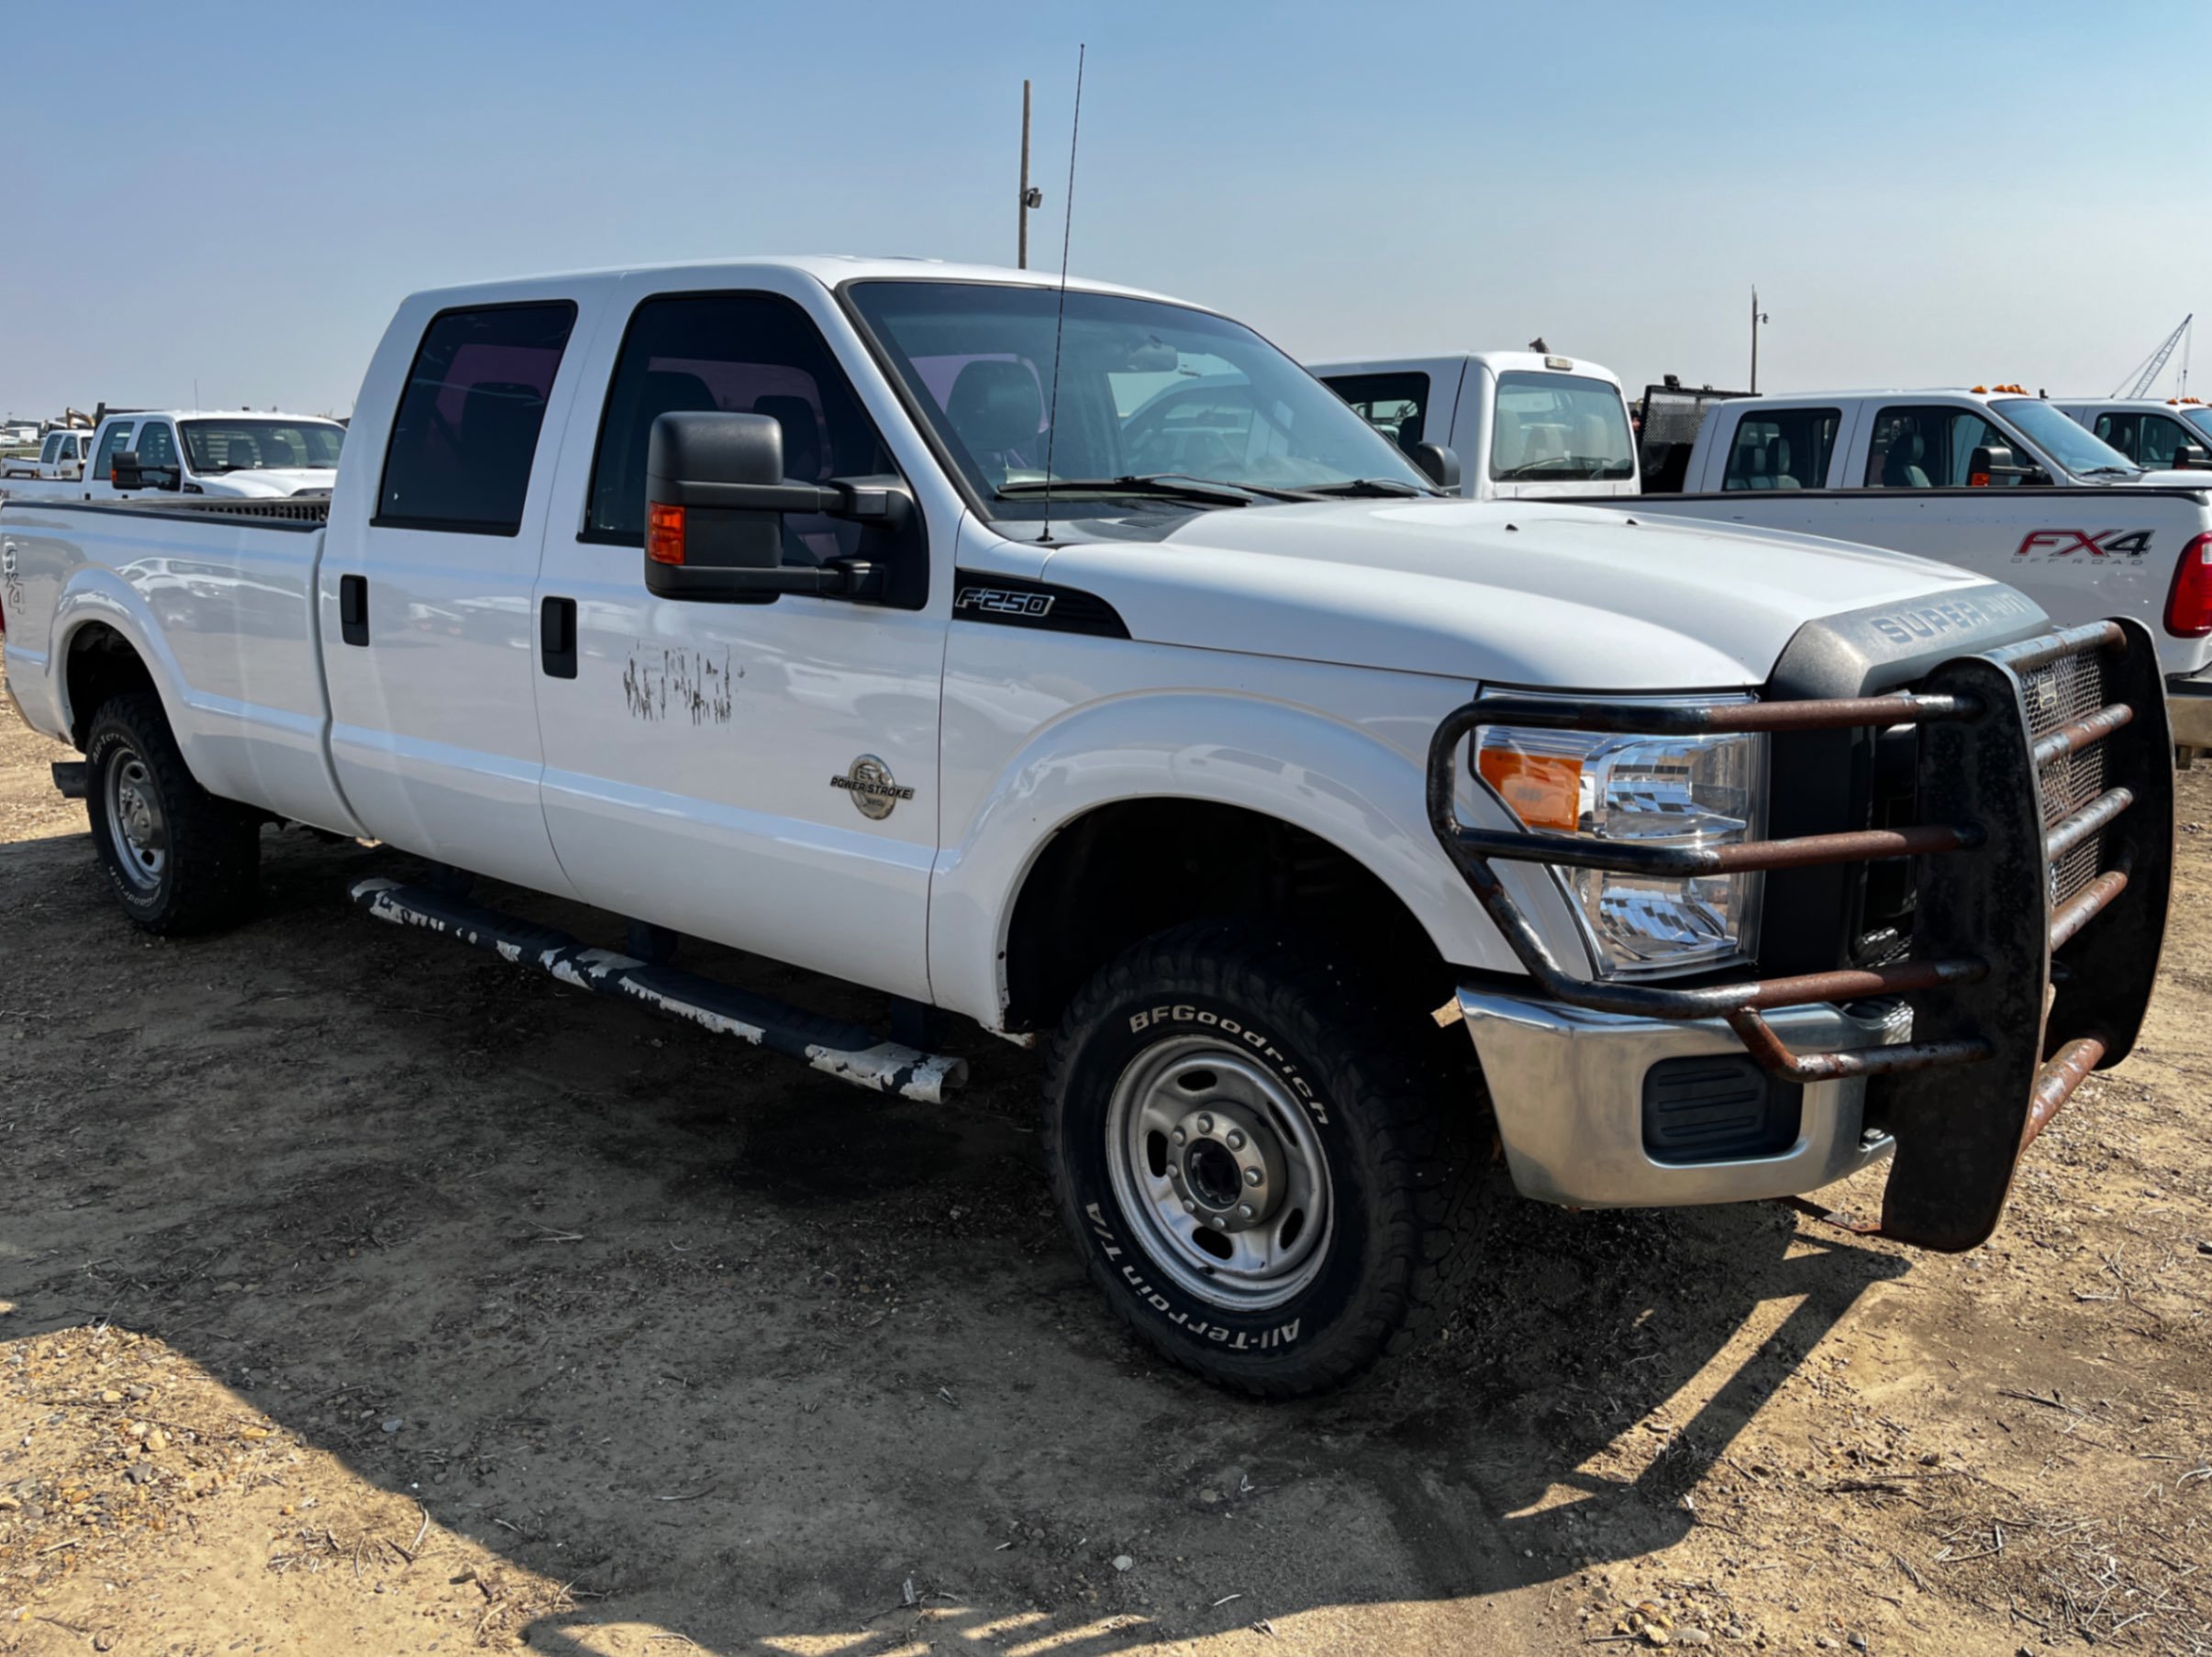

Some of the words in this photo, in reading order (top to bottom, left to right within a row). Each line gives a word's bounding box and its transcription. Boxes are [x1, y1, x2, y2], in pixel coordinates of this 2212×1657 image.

[2015, 529, 2155, 558] FX4
[955, 587, 1054, 617] F-250
[1871, 602, 1990, 643] SUPER
[829, 776, 866, 791] POWER
[867, 784, 912, 799] STROKE
[1129, 1005, 1329, 1125] BFGoodrich
[1086, 1202, 1123, 1262] T/A
[1122, 1265, 1301, 1350] All-Terrain
